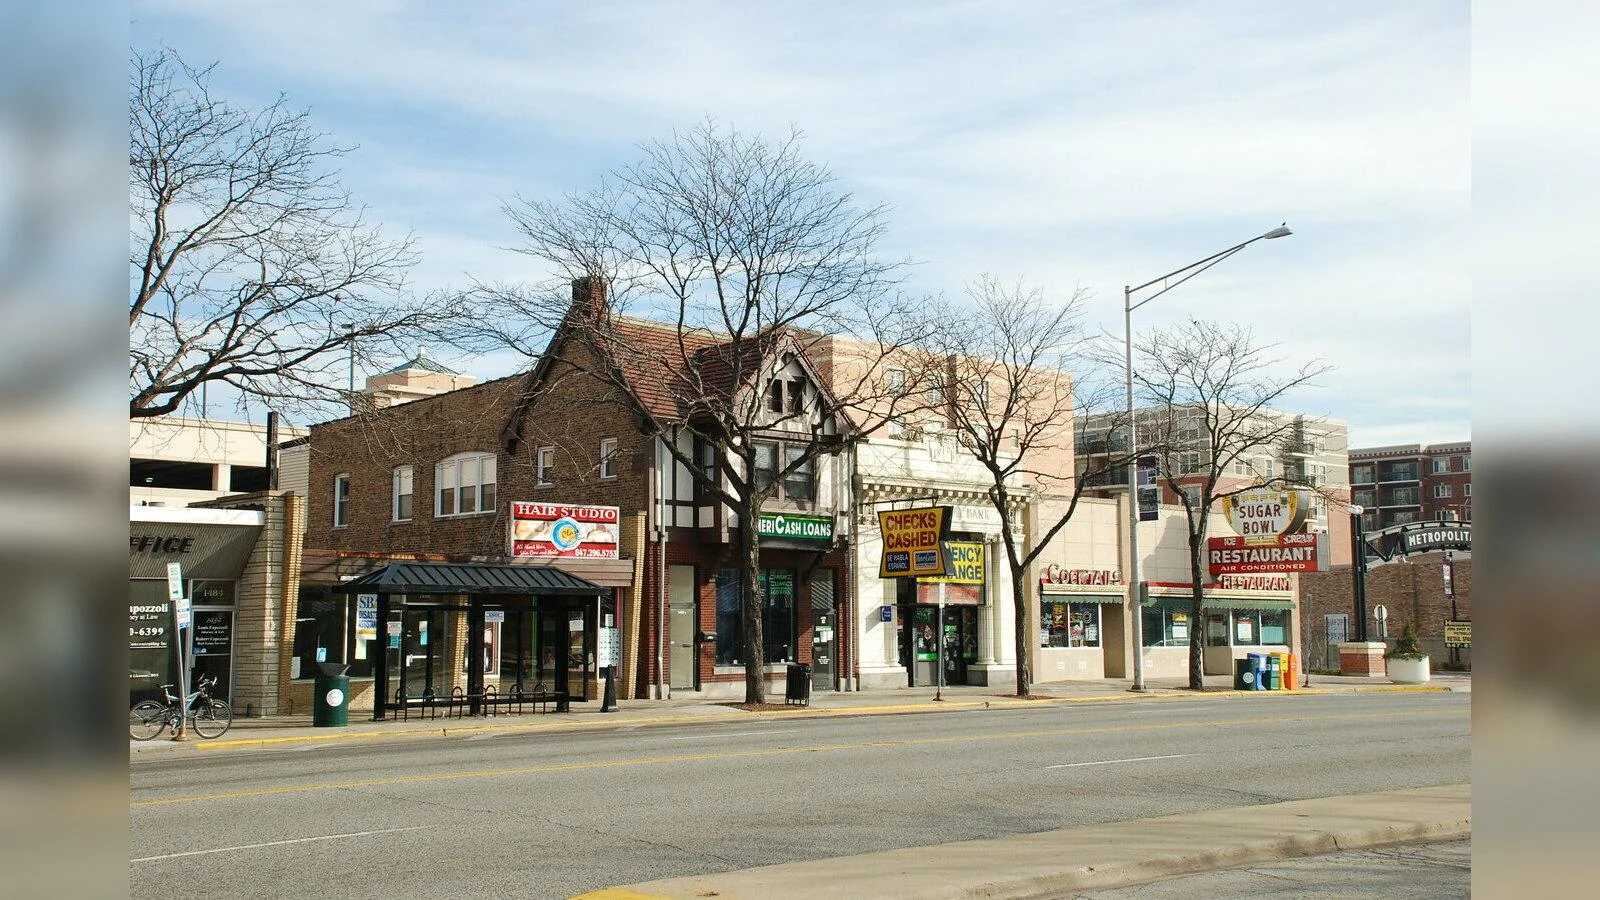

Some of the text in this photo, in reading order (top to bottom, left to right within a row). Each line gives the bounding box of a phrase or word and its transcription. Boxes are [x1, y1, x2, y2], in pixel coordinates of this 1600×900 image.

[518, 504, 616, 519] HAIR STUDIO
[1239, 504, 1281, 519] SUGAR
[803, 522, 832, 536] LOANS
[885, 512, 937, 531] CHECKS
[1243, 520, 1278, 534] BOWL
[886, 530, 937, 549] CASHED
[952, 547, 981, 562] ENCY
[1210, 547, 1314, 563] RESTAURANT
[1240, 563, 1306, 571] CONDITIONED
[1222, 575, 1292, 591] RESTAURANT
[359, 596, 375, 609] SB
